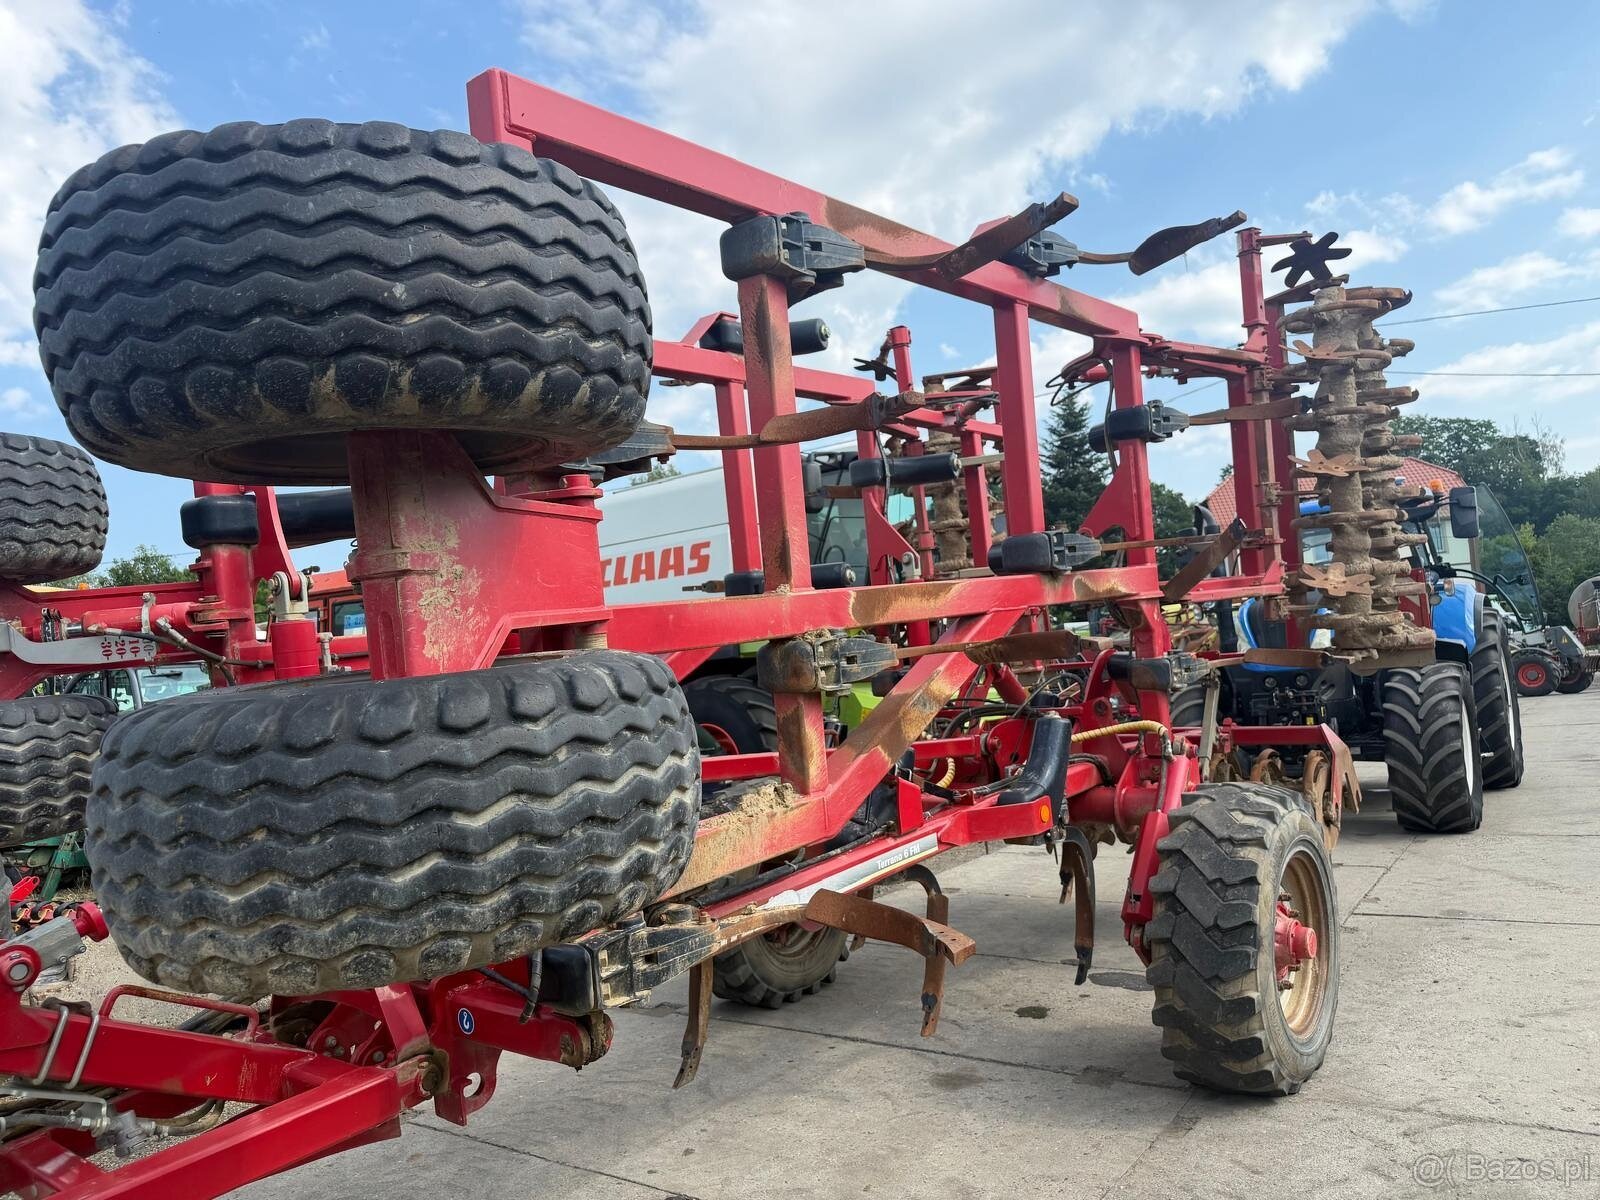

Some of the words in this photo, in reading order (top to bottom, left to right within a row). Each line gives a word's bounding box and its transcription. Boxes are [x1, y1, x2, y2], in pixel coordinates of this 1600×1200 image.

[600, 541, 711, 588] CLAAS
[876, 853, 903, 870] Terrano
[910, 843, 920, 856] FM
